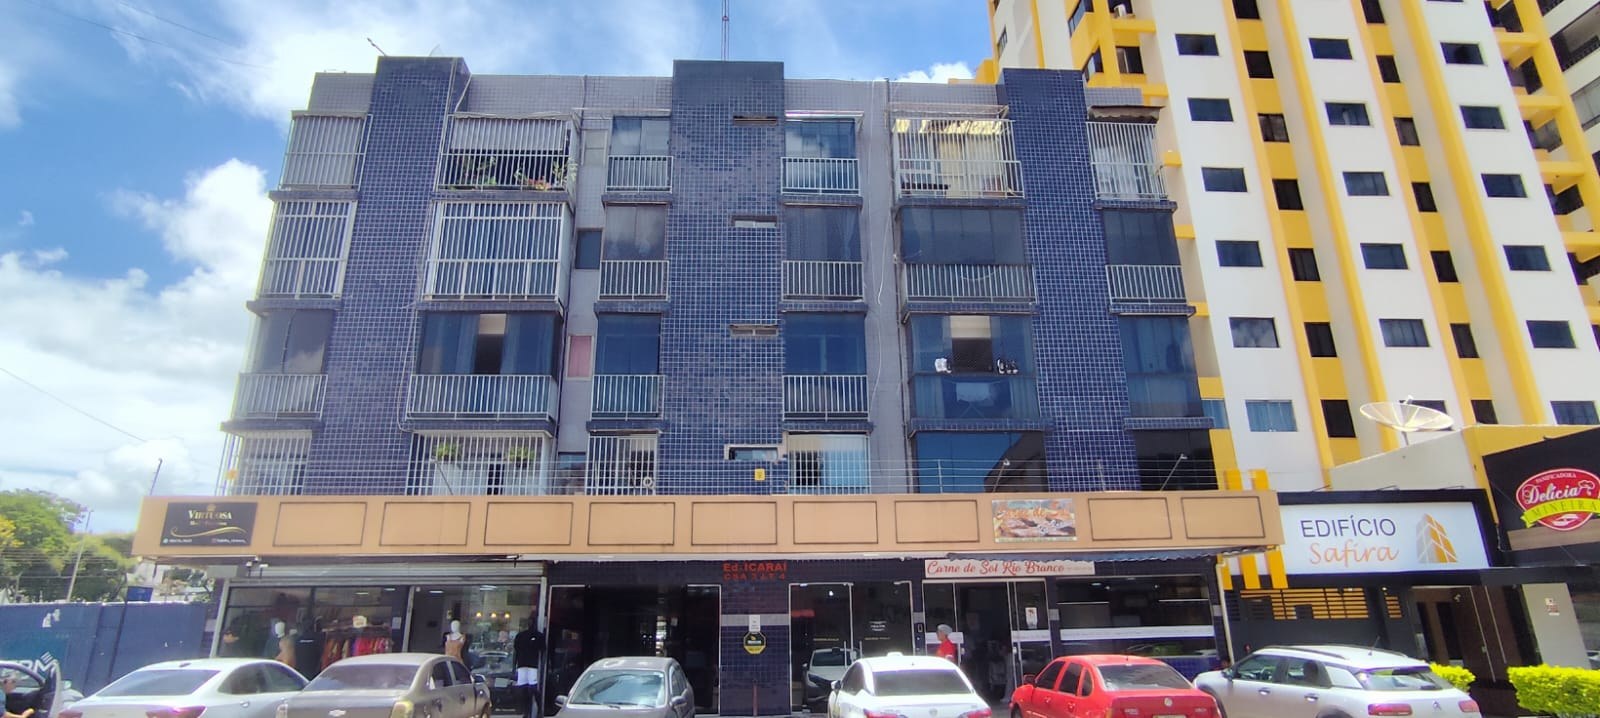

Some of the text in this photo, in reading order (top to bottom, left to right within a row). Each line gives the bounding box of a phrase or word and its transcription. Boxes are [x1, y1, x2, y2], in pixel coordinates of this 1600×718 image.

[1300, 515, 1396, 538] EDIFÍCIO
[1309, 539, 1399, 568] Safira
[927, 560, 1064, 575] Carne de Sol Rio Branco
